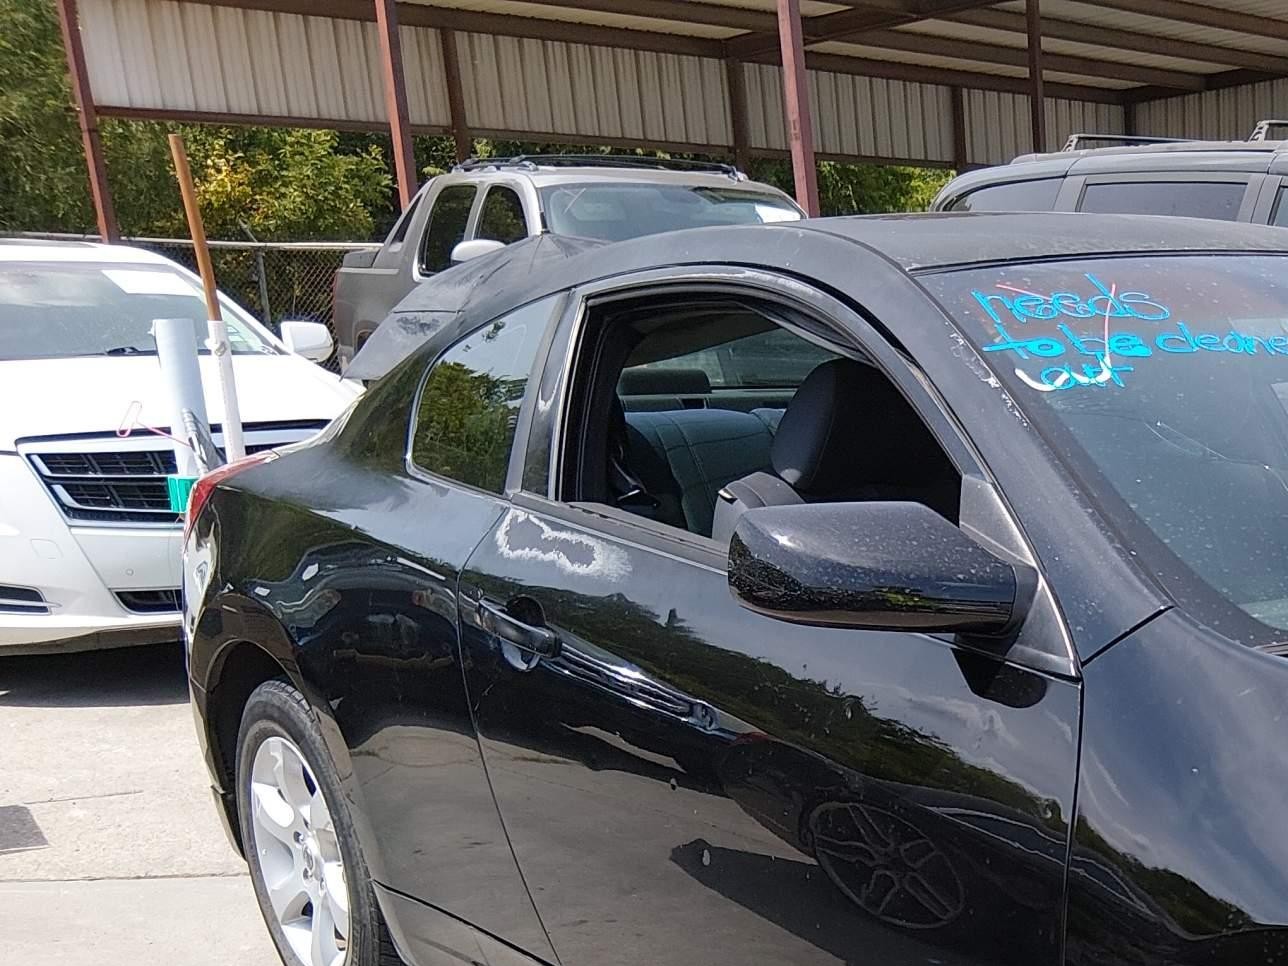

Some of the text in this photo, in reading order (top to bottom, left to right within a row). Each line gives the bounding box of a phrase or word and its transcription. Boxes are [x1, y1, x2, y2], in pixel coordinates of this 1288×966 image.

[971, 273, 1170, 323] needs
[983, 322, 1066, 359] to
[1057, 323, 1153, 357] be
[1040, 352, 1135, 390] out
